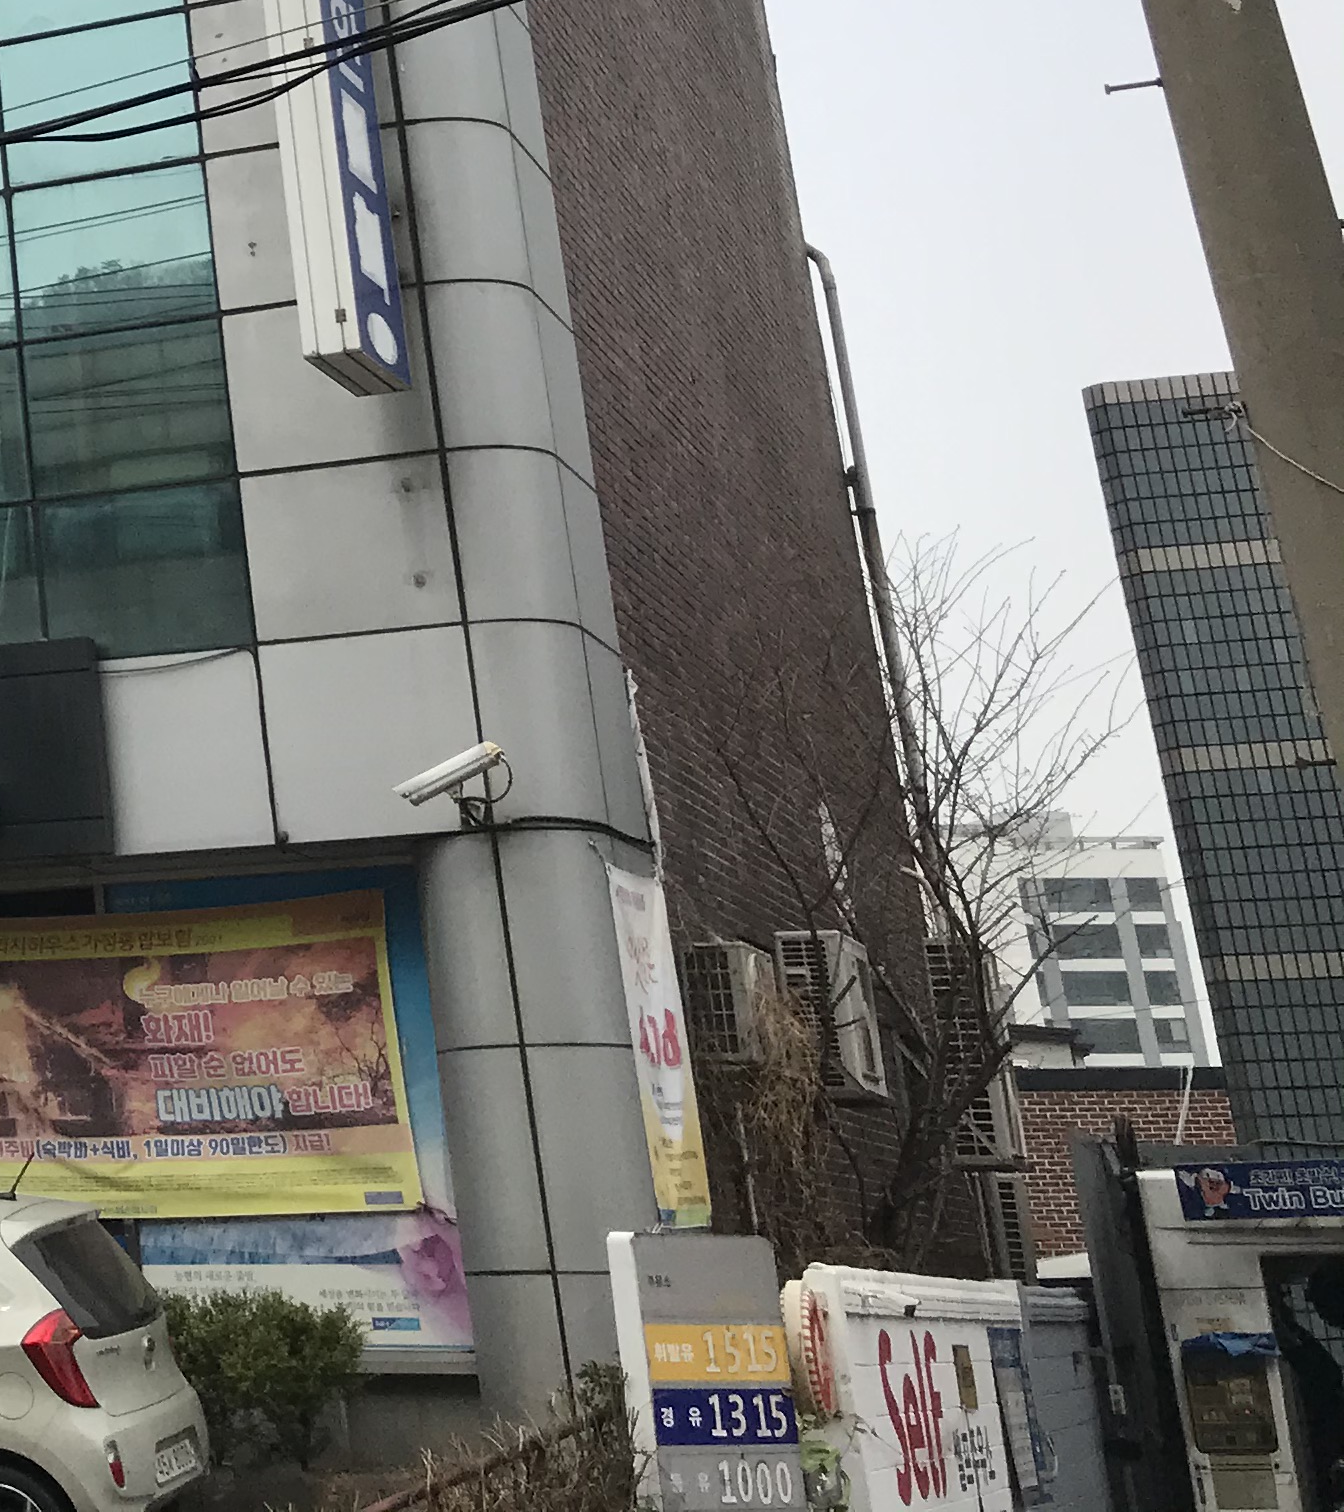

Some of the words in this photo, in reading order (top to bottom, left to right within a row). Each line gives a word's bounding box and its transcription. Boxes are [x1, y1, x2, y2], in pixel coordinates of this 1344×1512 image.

[138, 982, 230, 1007] 누구에게나
[229, 975, 288, 1002] 일어날
[290, 973, 311, 996] 수
[313, 970, 353, 994] 있는
[140, 1009, 214, 1045] 화재!
[149, 1054, 197, 1082] 피할
[201, 1052, 227, 1080] 순
[231, 1047, 306, 1078] 없어도
[156, 1084, 284, 1123] 대비해야
[284, 1081, 372, 1116] 합니다!
[292, 1133, 332, 1153] 지급!
[1242, 1186, 1306, 1211] Twin
[654, 1341, 695, 1364] 휘발유
[703, 1328, 779, 1374] 1515
[708, 1392, 789, 1438] 1315
[878, 1329, 947, 1506] Self
[718, 1458, 793, 1506] 1000
